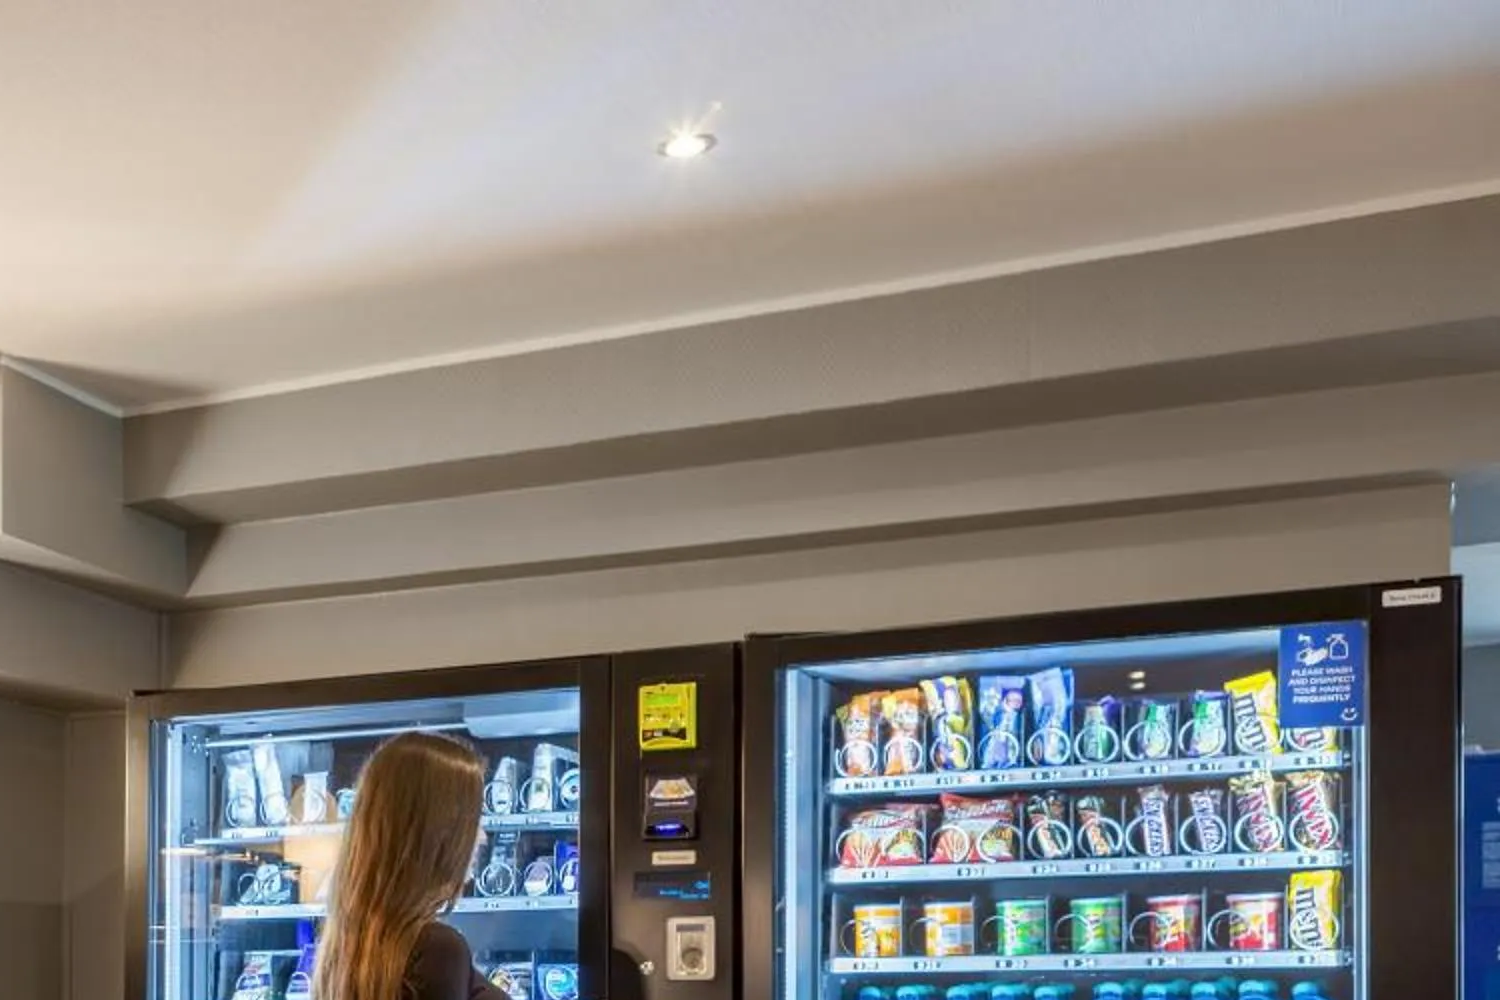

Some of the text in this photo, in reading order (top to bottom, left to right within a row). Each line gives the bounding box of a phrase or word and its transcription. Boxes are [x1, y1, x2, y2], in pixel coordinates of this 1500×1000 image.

[1291, 665, 1353, 676] PLEASE WASH
[1288, 675, 1355, 686] AND DISINFECT
